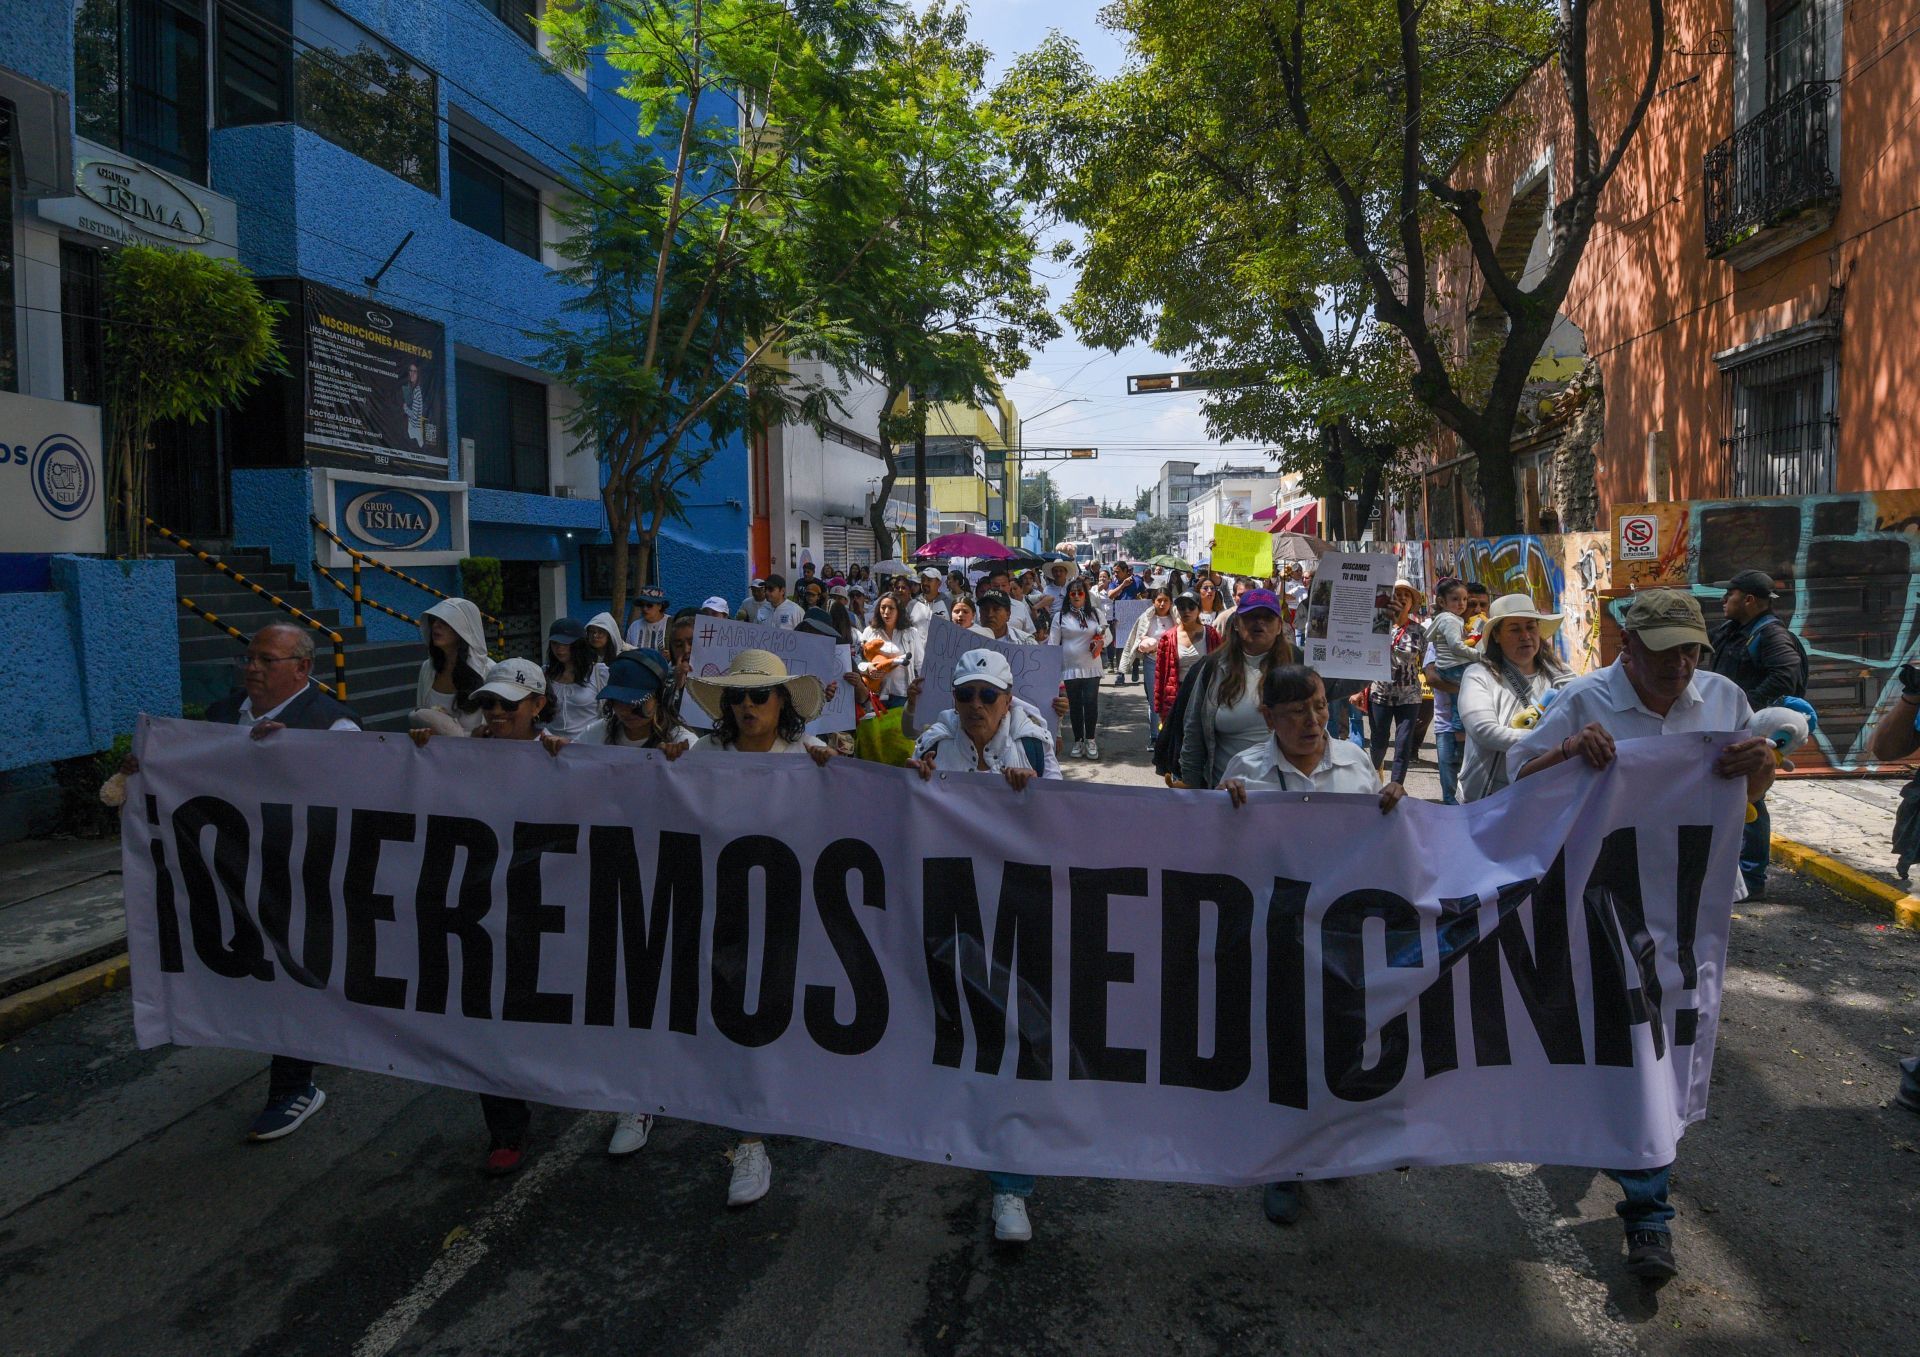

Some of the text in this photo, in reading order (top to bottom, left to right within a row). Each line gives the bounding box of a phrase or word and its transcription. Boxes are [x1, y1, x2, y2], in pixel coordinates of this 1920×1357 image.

[97, 167, 130, 185] GRUPO
[103, 184, 185, 230] ISIMA
[319, 313, 433, 359] INSCRIPCIONES ABIERTAS
[309, 409, 352, 424] DOCTORADOS
[375, 455, 389, 465] ISEU
[56, 491, 75, 503] ISEU
[363, 501, 393, 512] GRUPO
[365, 511, 425, 530] ISIMA
[1341, 562, 1371, 571] BUSCAMOS
[1350, 573, 1368, 582] AYUDA
[515, 670, 525, 684] LA
[145, 791, 1714, 1110] ¡QUEREMOS MEDICINA!
